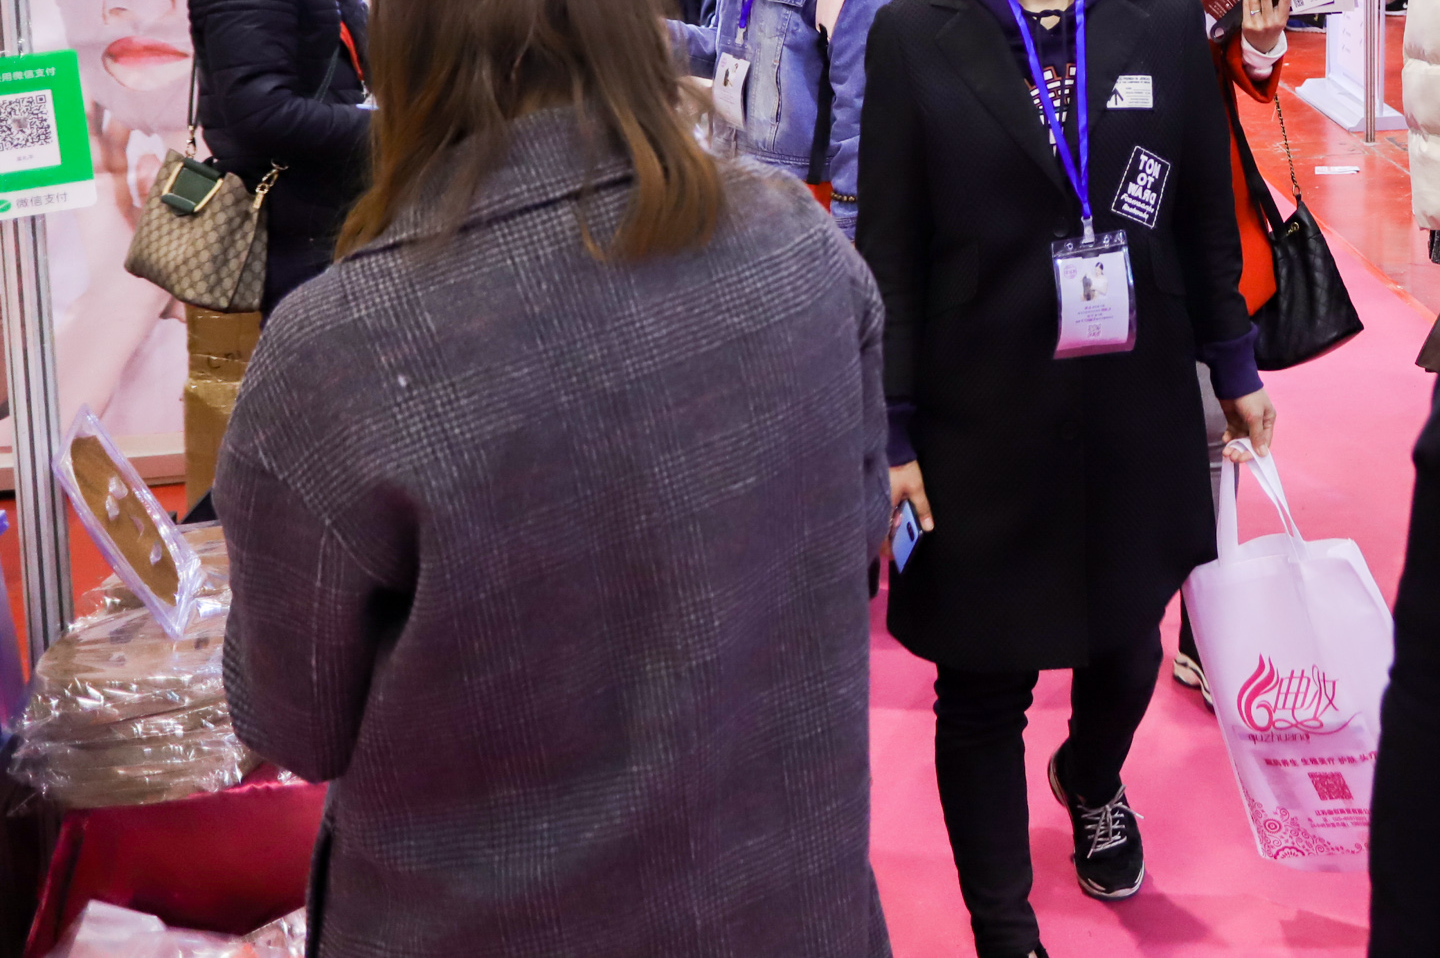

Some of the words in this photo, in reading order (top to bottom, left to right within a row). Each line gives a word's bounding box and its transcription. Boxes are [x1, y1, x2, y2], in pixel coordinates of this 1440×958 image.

[0, 66, 56, 83] 用微信支付
[16, 191, 68, 209] 微信支付
